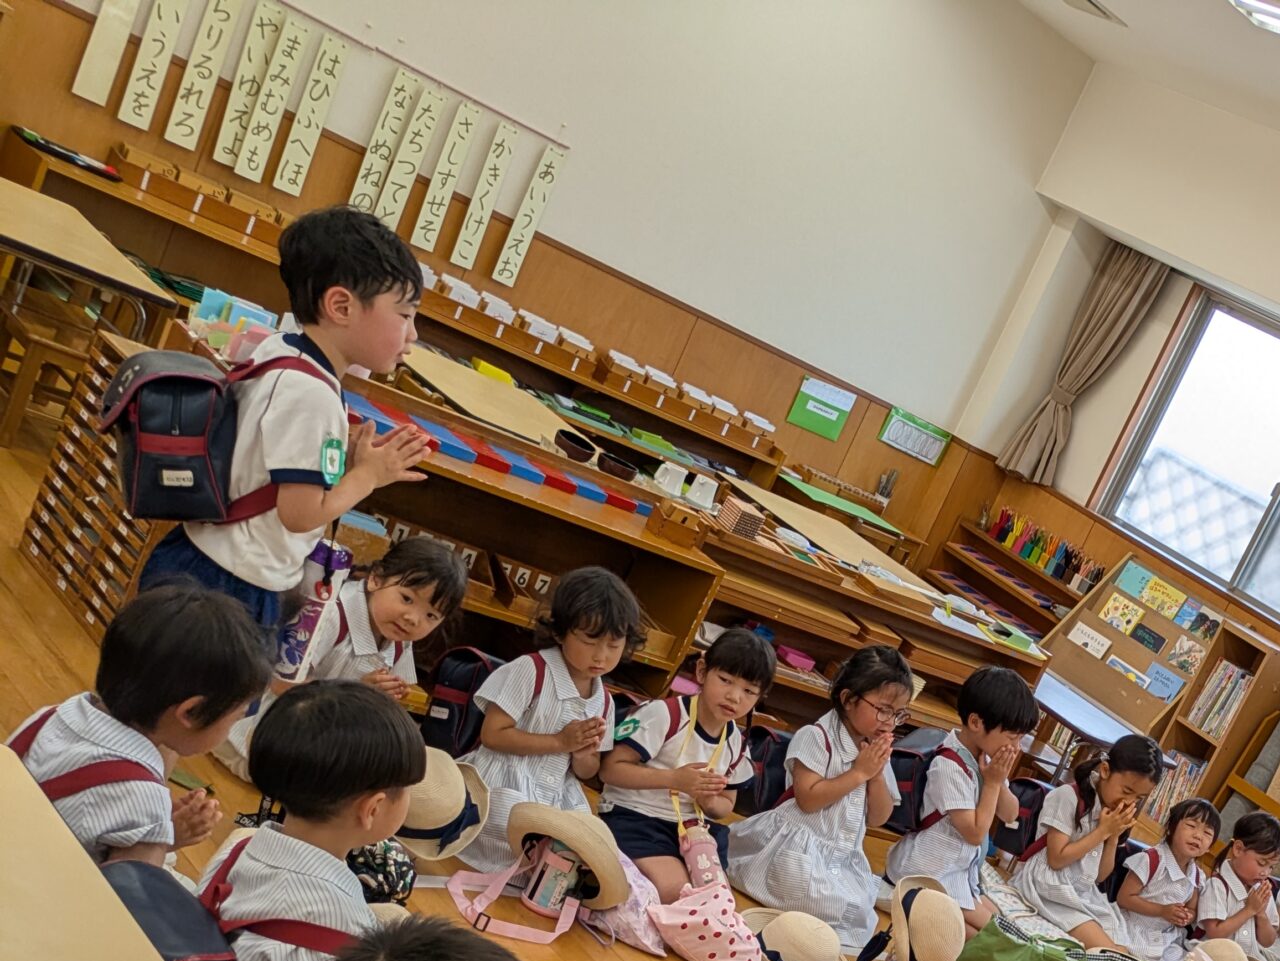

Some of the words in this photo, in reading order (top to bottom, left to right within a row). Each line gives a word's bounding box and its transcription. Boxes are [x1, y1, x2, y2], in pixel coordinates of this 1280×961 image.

[174, 0, 231, 137] らりるれろ
[222, 16, 279, 158] やいゆえよ
[247, 36, 301, 171] まみむめも
[279, 50, 341, 187] はひふへほ
[353, 84, 412, 211] なにぬねの
[419, 117, 473, 242] さしすせそ
[458, 138, 512, 260] かきくけこ
[497, 161, 555, 279] あいうえお
[464, 553, 474, 568] 4
[517, 572, 527, 586] 6
[537, 579, 548, 593] 7
